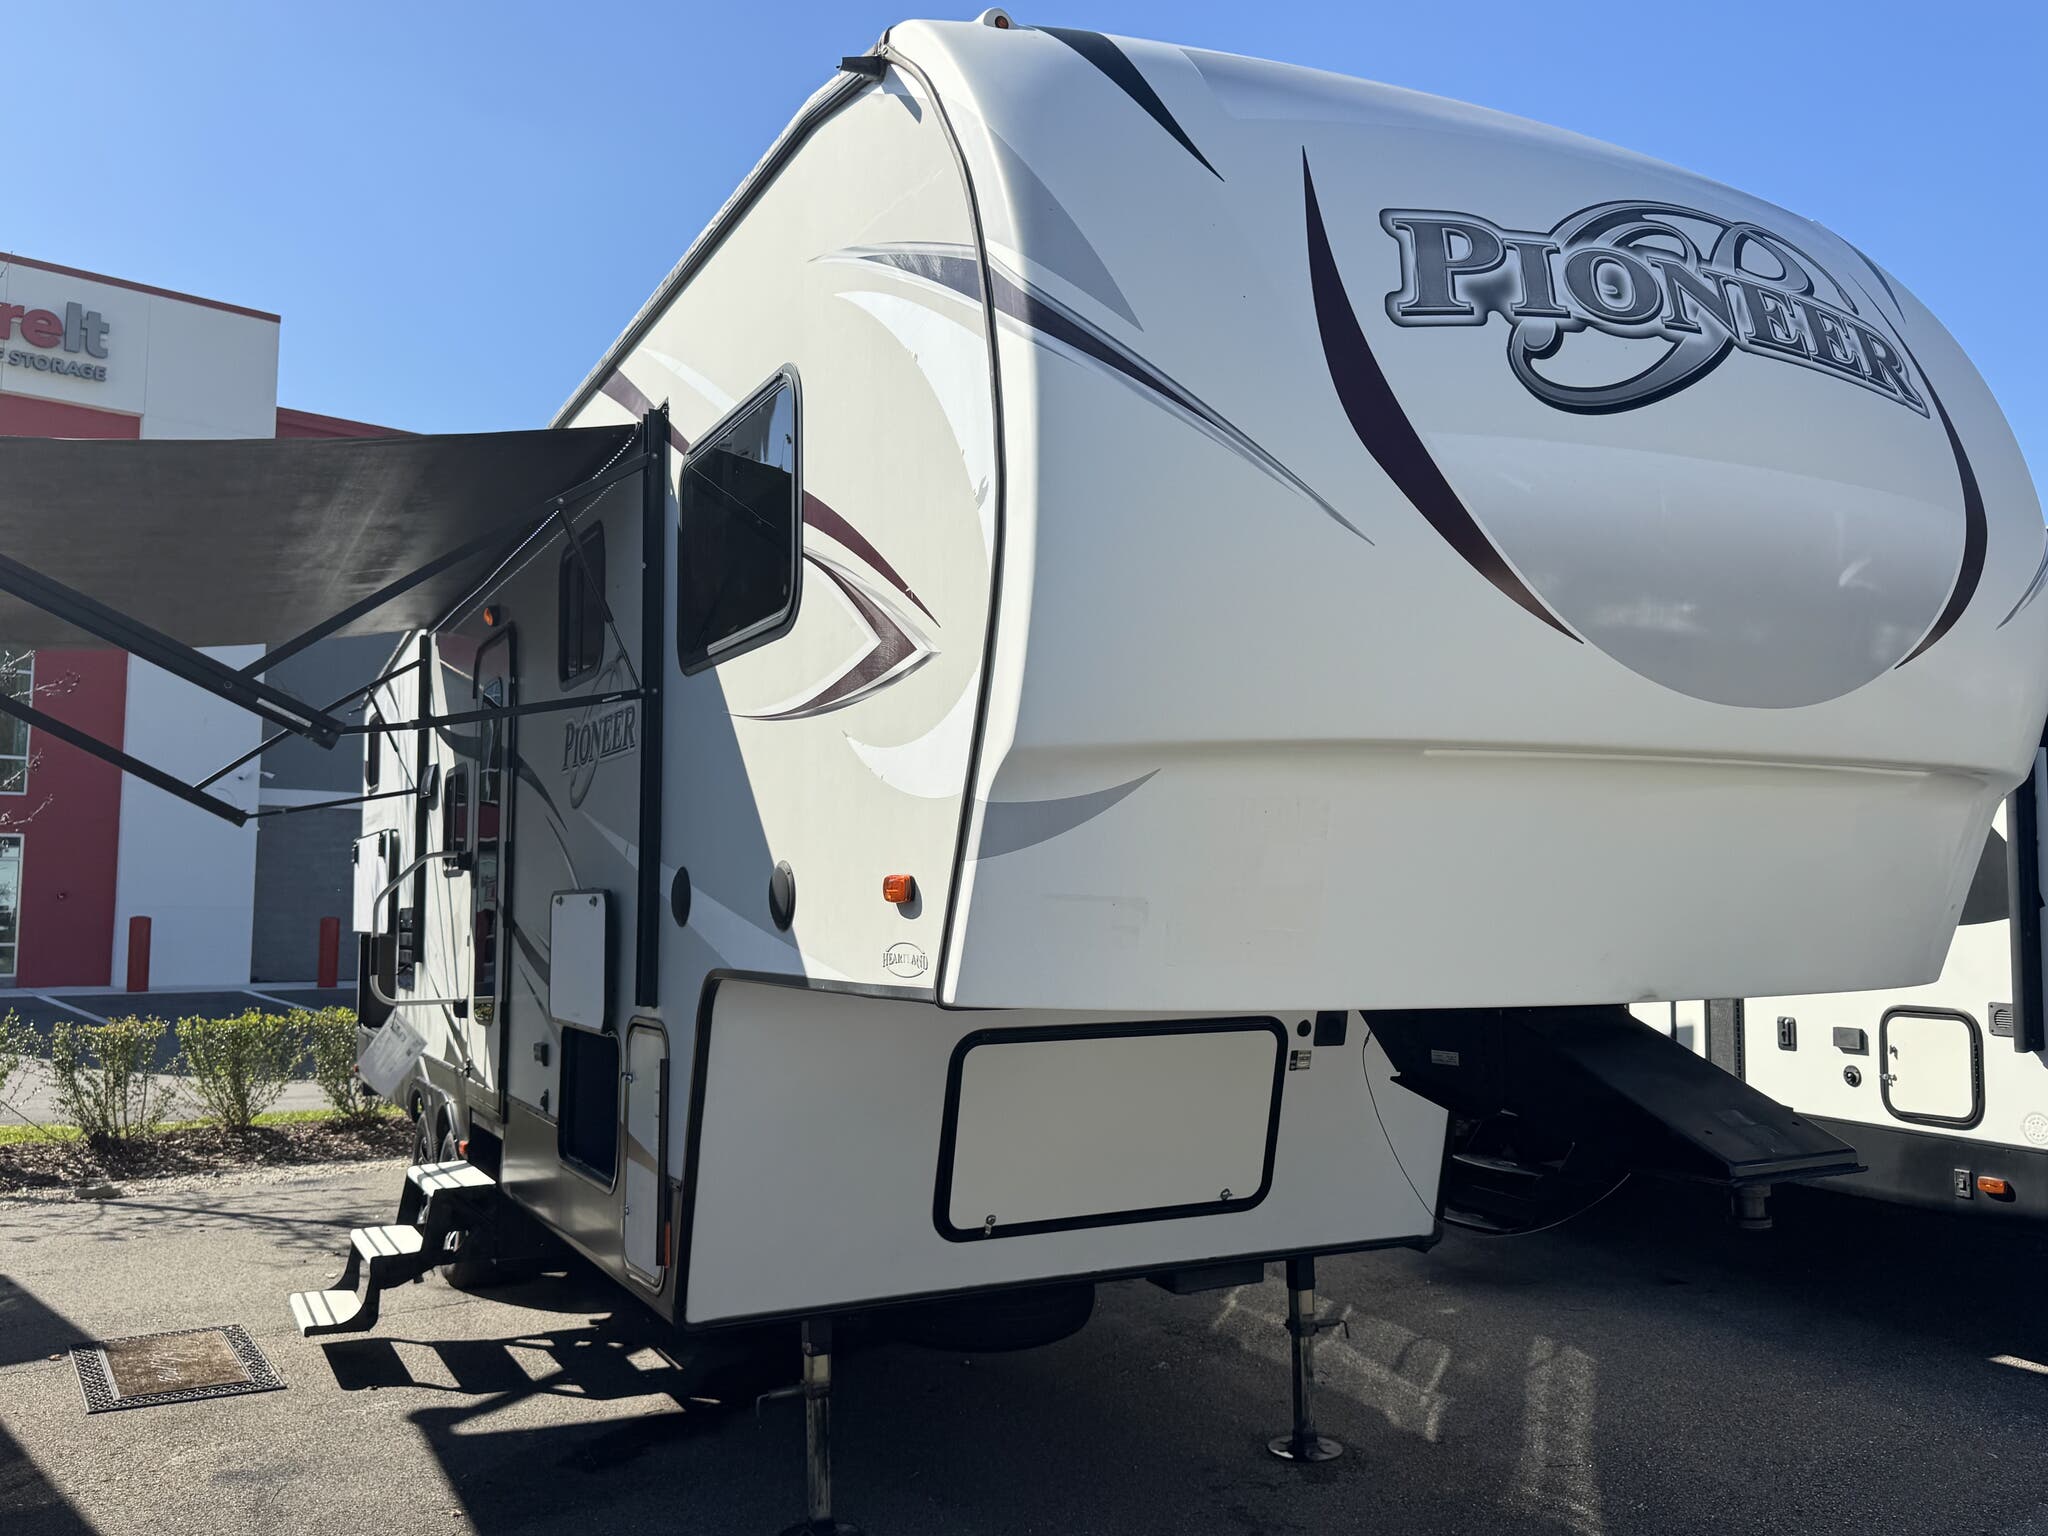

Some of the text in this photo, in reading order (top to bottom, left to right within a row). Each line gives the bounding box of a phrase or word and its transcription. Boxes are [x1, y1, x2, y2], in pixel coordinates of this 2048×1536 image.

[1381, 208, 1931, 418] PIONEER
[8, 350, 107, 382] STORAGE
[561, 705, 636, 772] PIONEER
[882, 952, 929, 970] HEARTLAND
